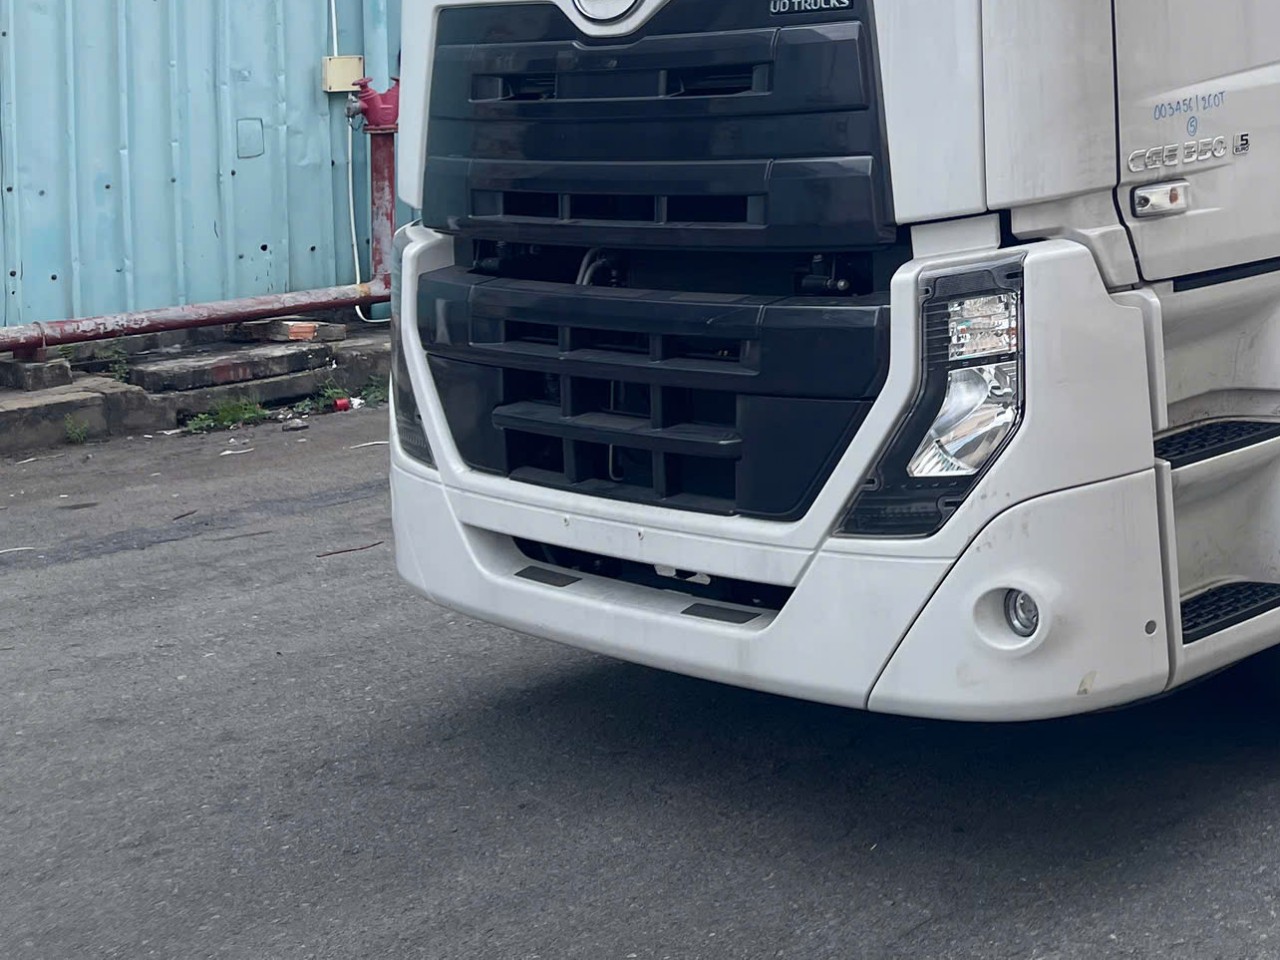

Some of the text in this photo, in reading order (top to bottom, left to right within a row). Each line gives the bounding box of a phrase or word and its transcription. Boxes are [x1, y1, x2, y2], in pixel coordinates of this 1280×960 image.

[769, 0, 790, 13] UD
[1240, 133, 1249, 146] 5
[1182, 135, 1227, 165] 350
